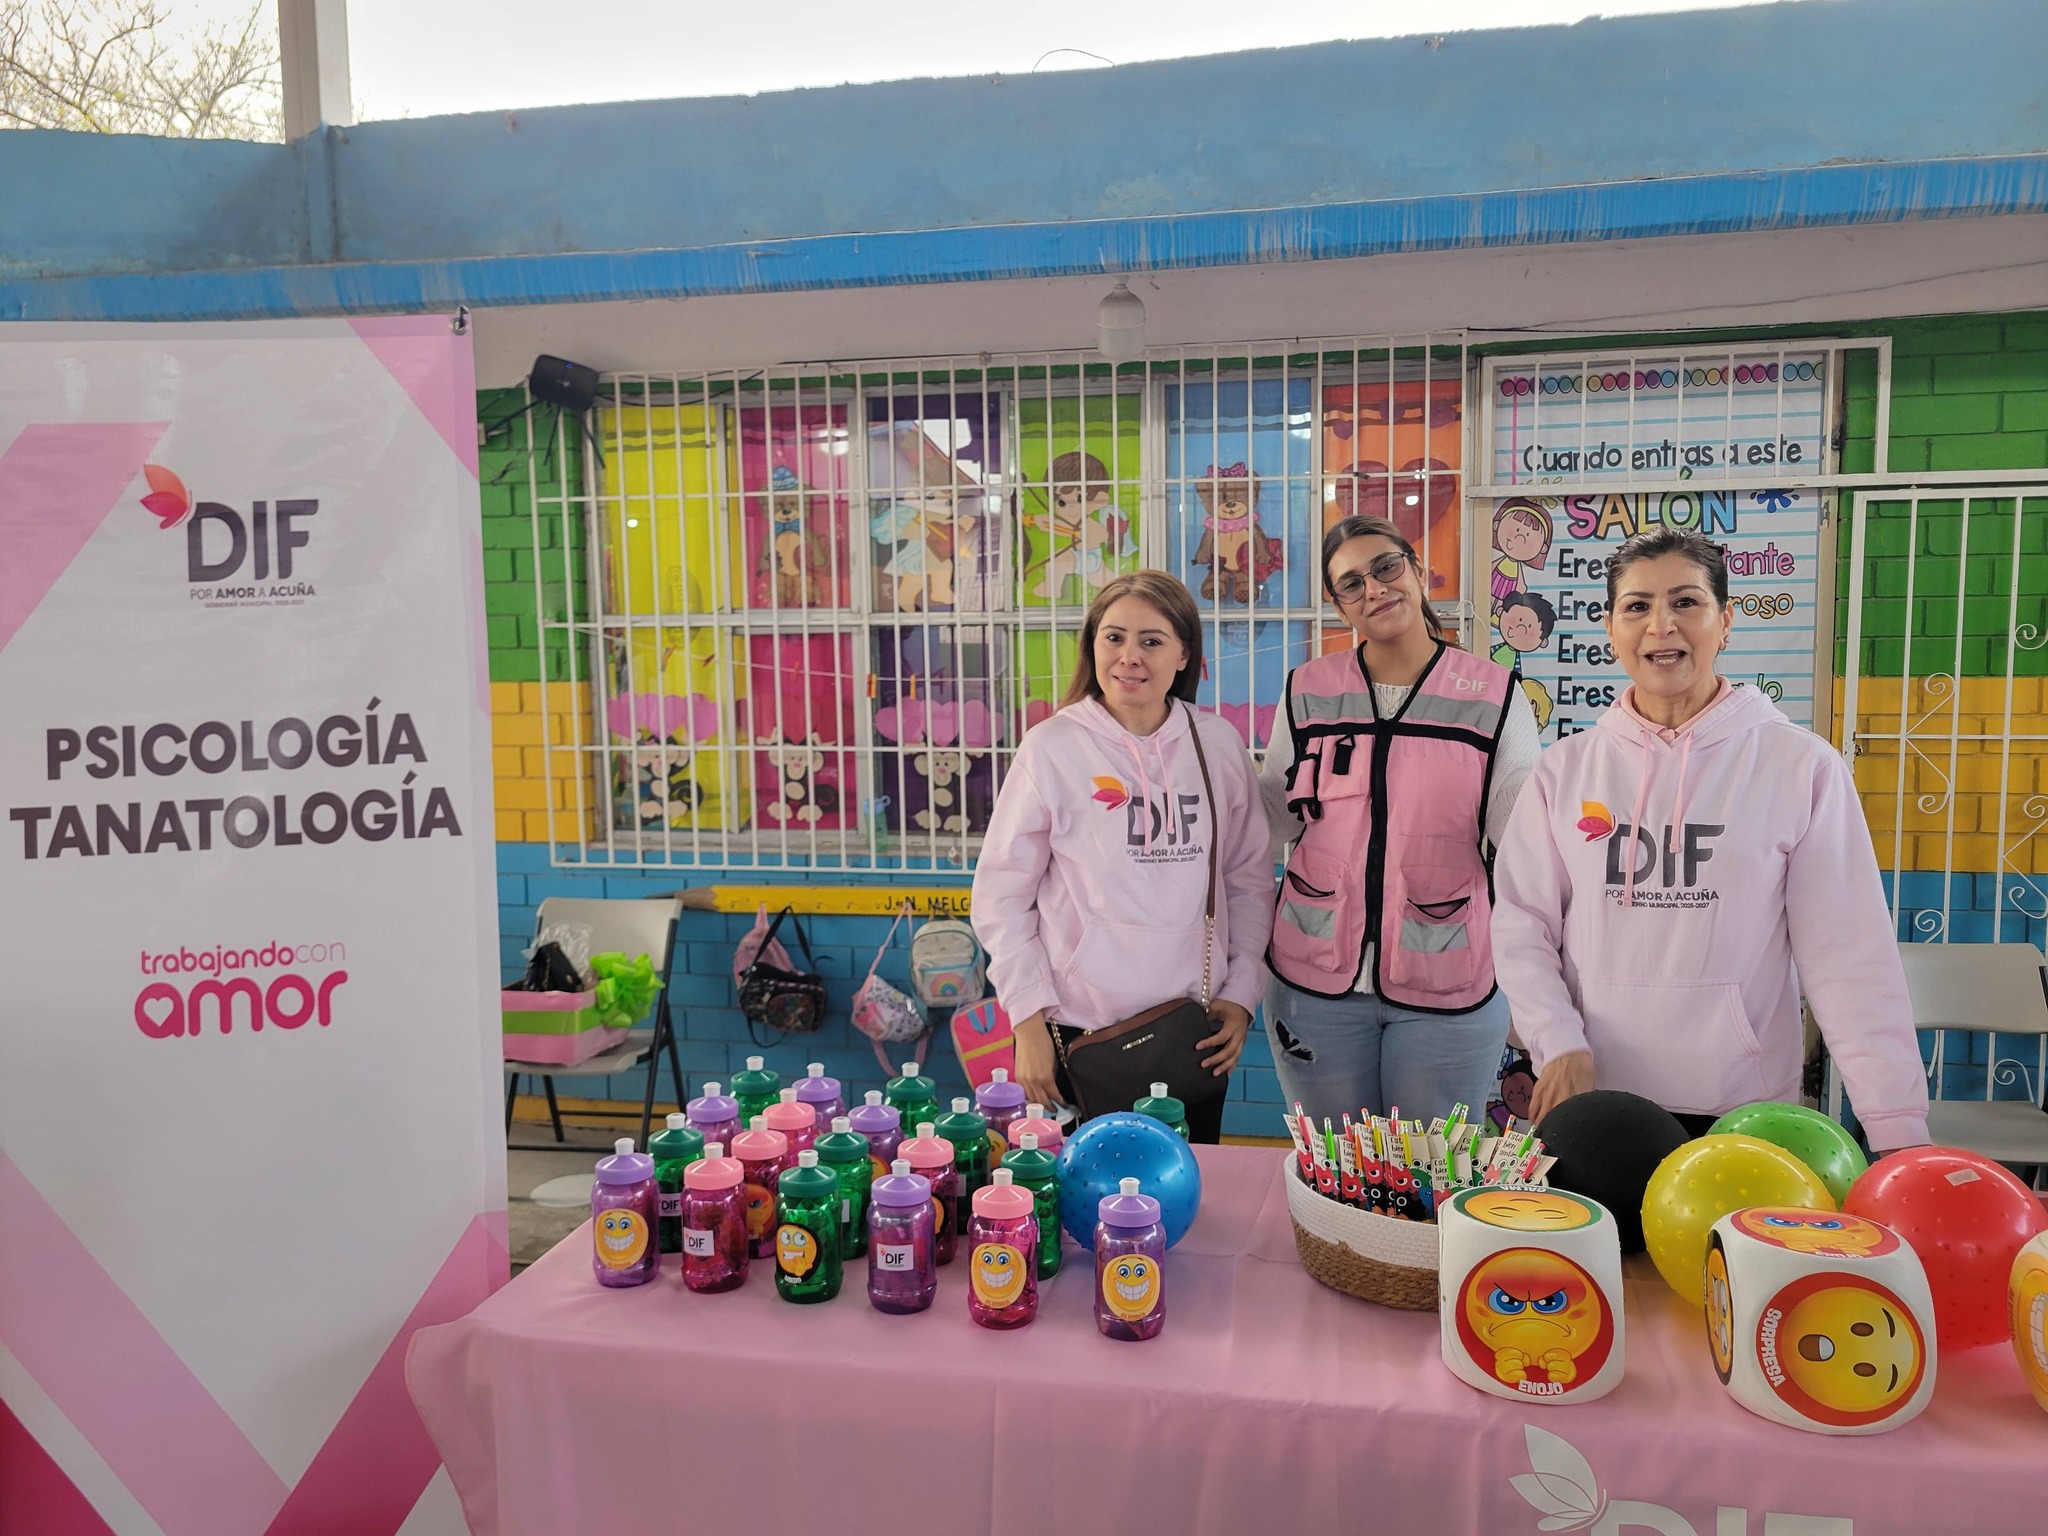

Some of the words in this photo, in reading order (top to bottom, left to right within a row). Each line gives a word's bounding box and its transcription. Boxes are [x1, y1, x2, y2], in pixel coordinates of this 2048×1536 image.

[1523, 441, 1622, 472] Cuando
[1632, 439, 1714, 470] entras
[1722, 443, 1739, 465] a
[1747, 433, 1803, 465] este
[1564, 466, 1737, 540] SALÓN
[187, 497, 319, 583] DIF
[190, 588, 213, 600] POR
[215, 587, 256, 599] AMOR
[258, 586, 267, 597] A
[268, 582, 316, 597] ACUÑA
[1557, 634, 1617, 666] Eres
[1455, 677, 1489, 692] DIF
[1557, 677, 1616, 708] Eres
[46, 695, 428, 780] PSICOLOGÍA
[9, 770, 463, 860] TANATOLOGÍA
[1126, 792, 1200, 846] DIF
[1177, 844, 1204, 856] ACUÑA
[1605, 823, 1726, 888] DIF
[1605, 889, 1625, 899] POR
[1631, 891, 1663, 901] AMOR
[1664, 892, 1673, 902] A
[1675, 888, 1720, 901] ACUÑA
[134, 969, 348, 1039] amor
[661, 1199, 680, 1211] DIF
[688, 1237, 705, 1249] DIF
[885, 1252, 905, 1265] DIF
[1760, 1307, 1786, 1388] SORPRESA
[1518, 1379, 1564, 1396] ENOJO
